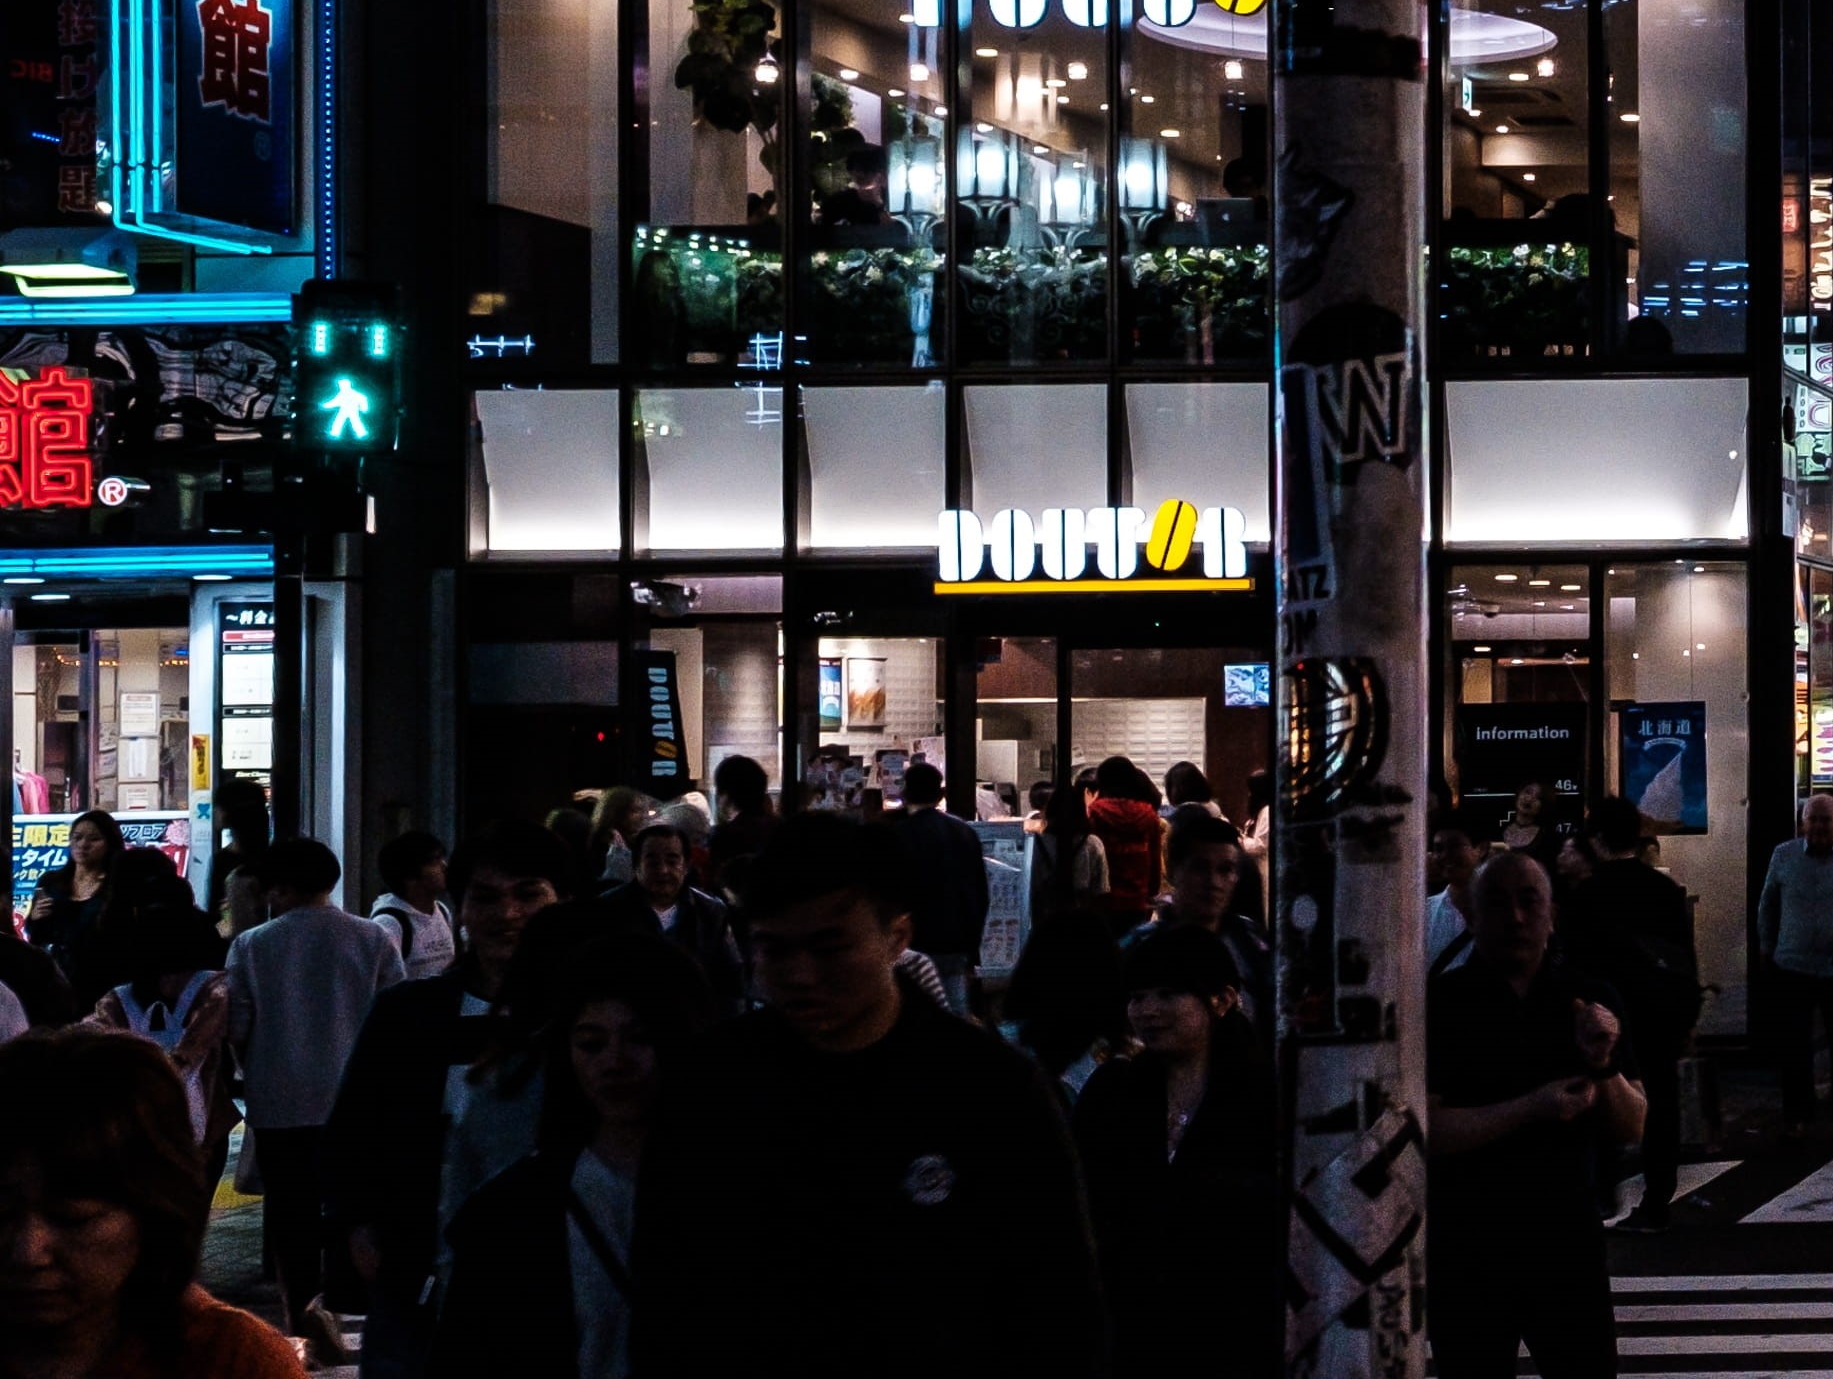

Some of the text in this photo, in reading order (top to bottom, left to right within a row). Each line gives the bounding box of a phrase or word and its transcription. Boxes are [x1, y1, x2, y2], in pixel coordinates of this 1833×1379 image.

[1475, 724, 1571, 742] information
[1637, 719, 1693, 737] 北海道
